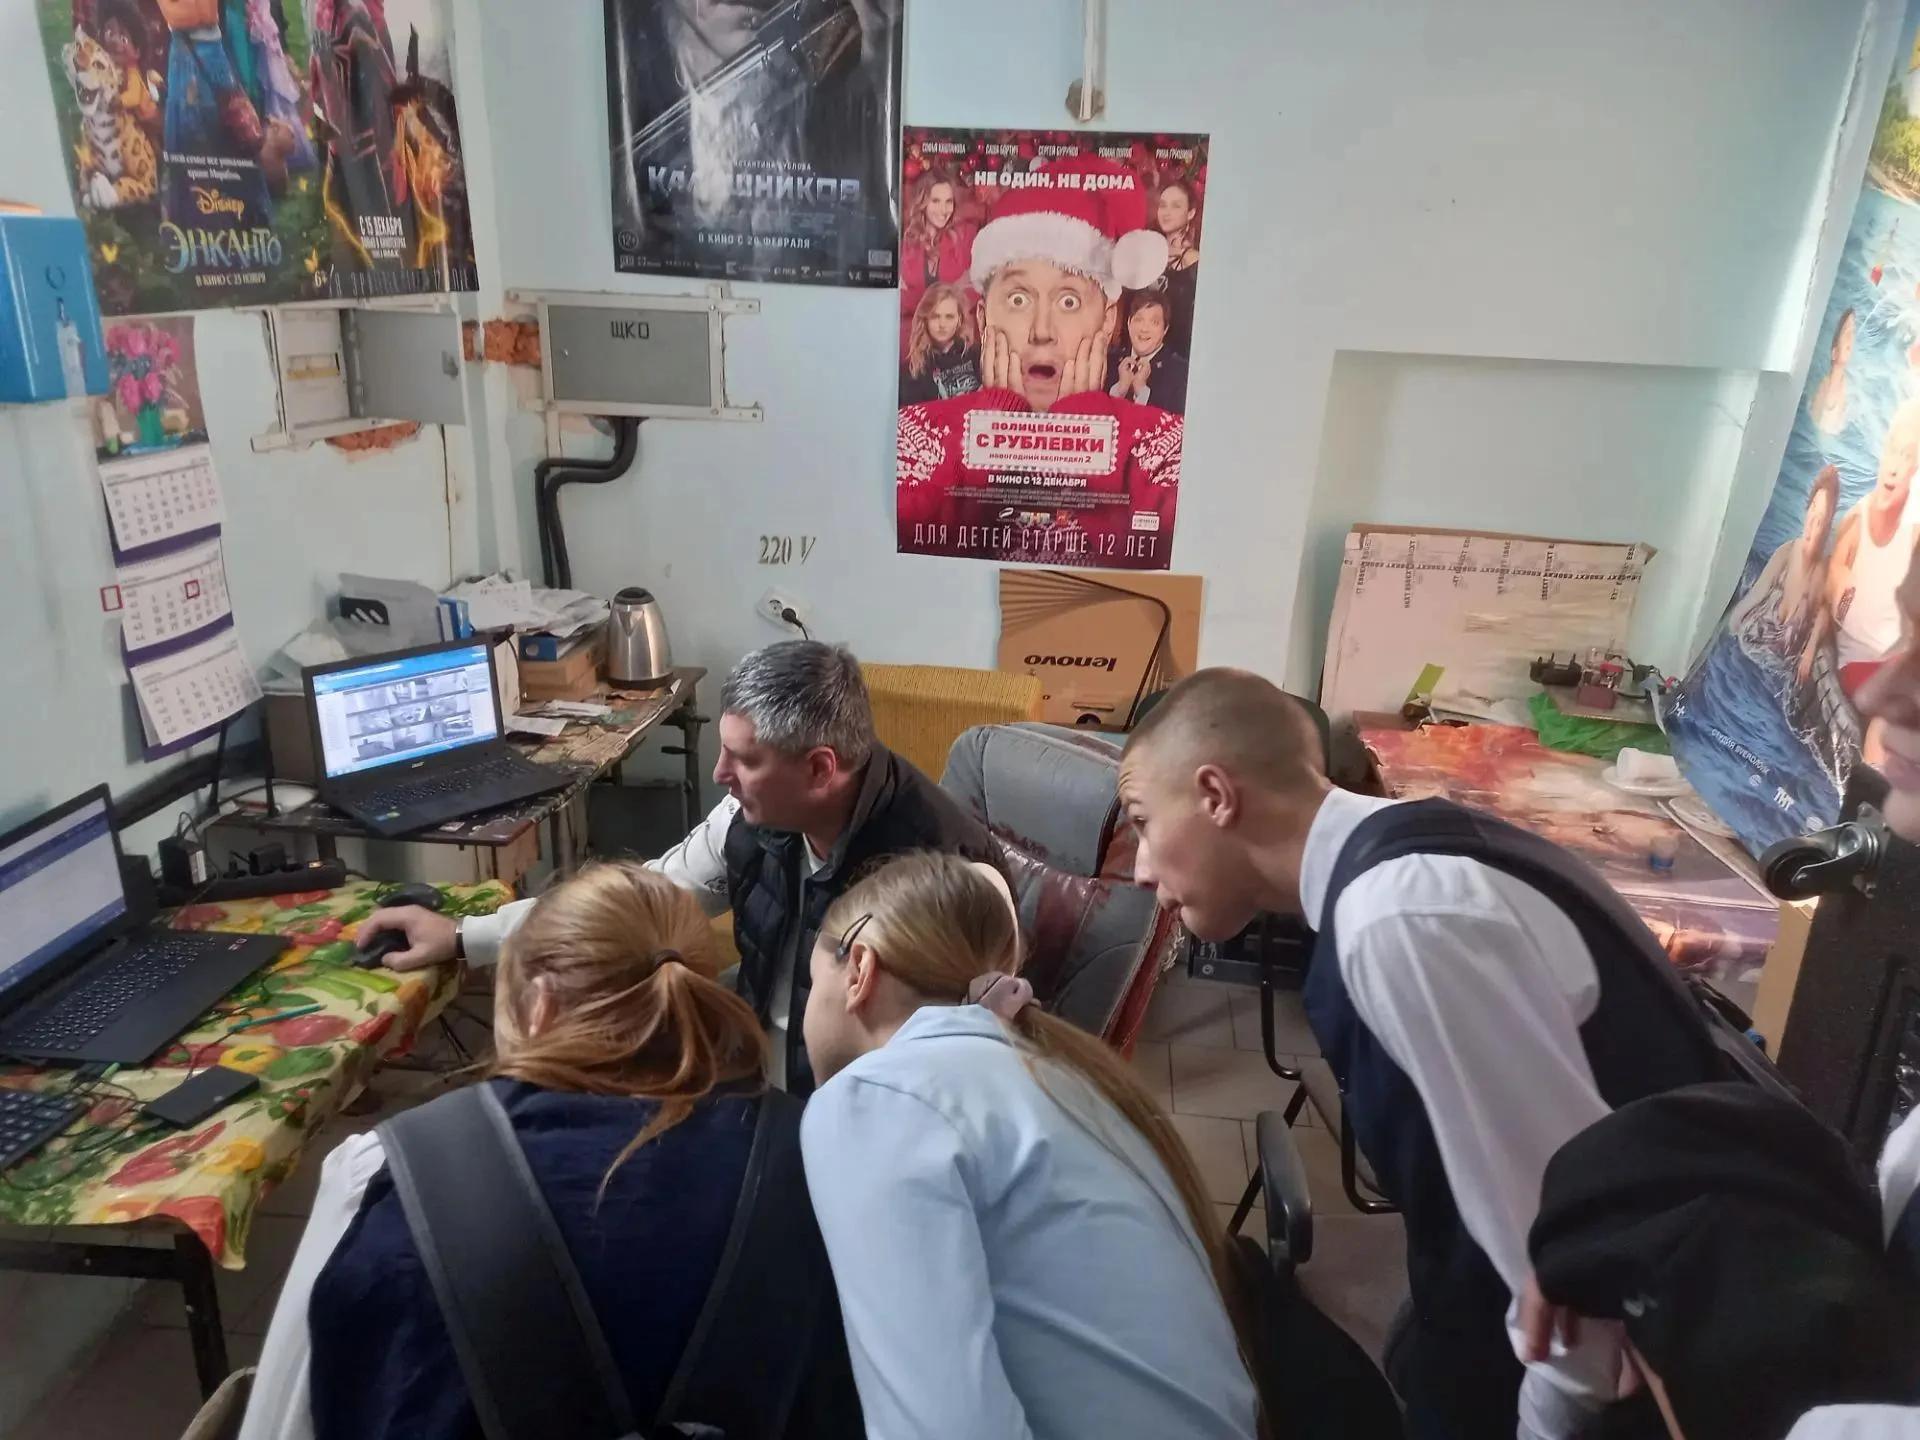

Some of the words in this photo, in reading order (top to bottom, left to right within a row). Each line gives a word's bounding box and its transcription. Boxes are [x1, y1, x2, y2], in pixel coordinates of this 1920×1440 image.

[974, 171, 998, 186] НЕ
[1000, 172, 1055, 190] ОДИН,
[1057, 172, 1081, 189] НЕ
[1083, 174, 1135, 192] ДОМА
[707, 233, 734, 246] КИНО
[737, 235, 744, 246] С
[763, 237, 811, 249] ФЕВРАЛЯ
[610, 320, 650, 341] ЩКО
[991, 421, 1091, 435] ПОЛИЦЕЙСКИЙ
[976, 433, 989, 448] С
[993, 434, 1105, 454] РУБЛЕВКИ
[1084, 455, 1092, 464] 2
[988, 474, 995, 483] В
[996, 474, 1021, 484] КИНО
[1023, 476, 1030, 485] С
[1031, 476, 1042, 486] 12
[1043, 478, 1088, 488] ДЕКАБРЯ
[758, 535, 792, 565] 220
[913, 522, 947, 545] ДЛЯ
[957, 523, 1012, 550] ДЕТЕЙ
[1021, 529, 1089, 554] СТАРШЕ
[1099, 533, 1115, 557] 12
[1125, 534, 1158, 559] ЛЕТ
[1023, 654, 1118, 672] lenovo
[1711, 728, 1736, 751] СТУДИЯ
[1773, 786, 1795, 812] ТНТ
